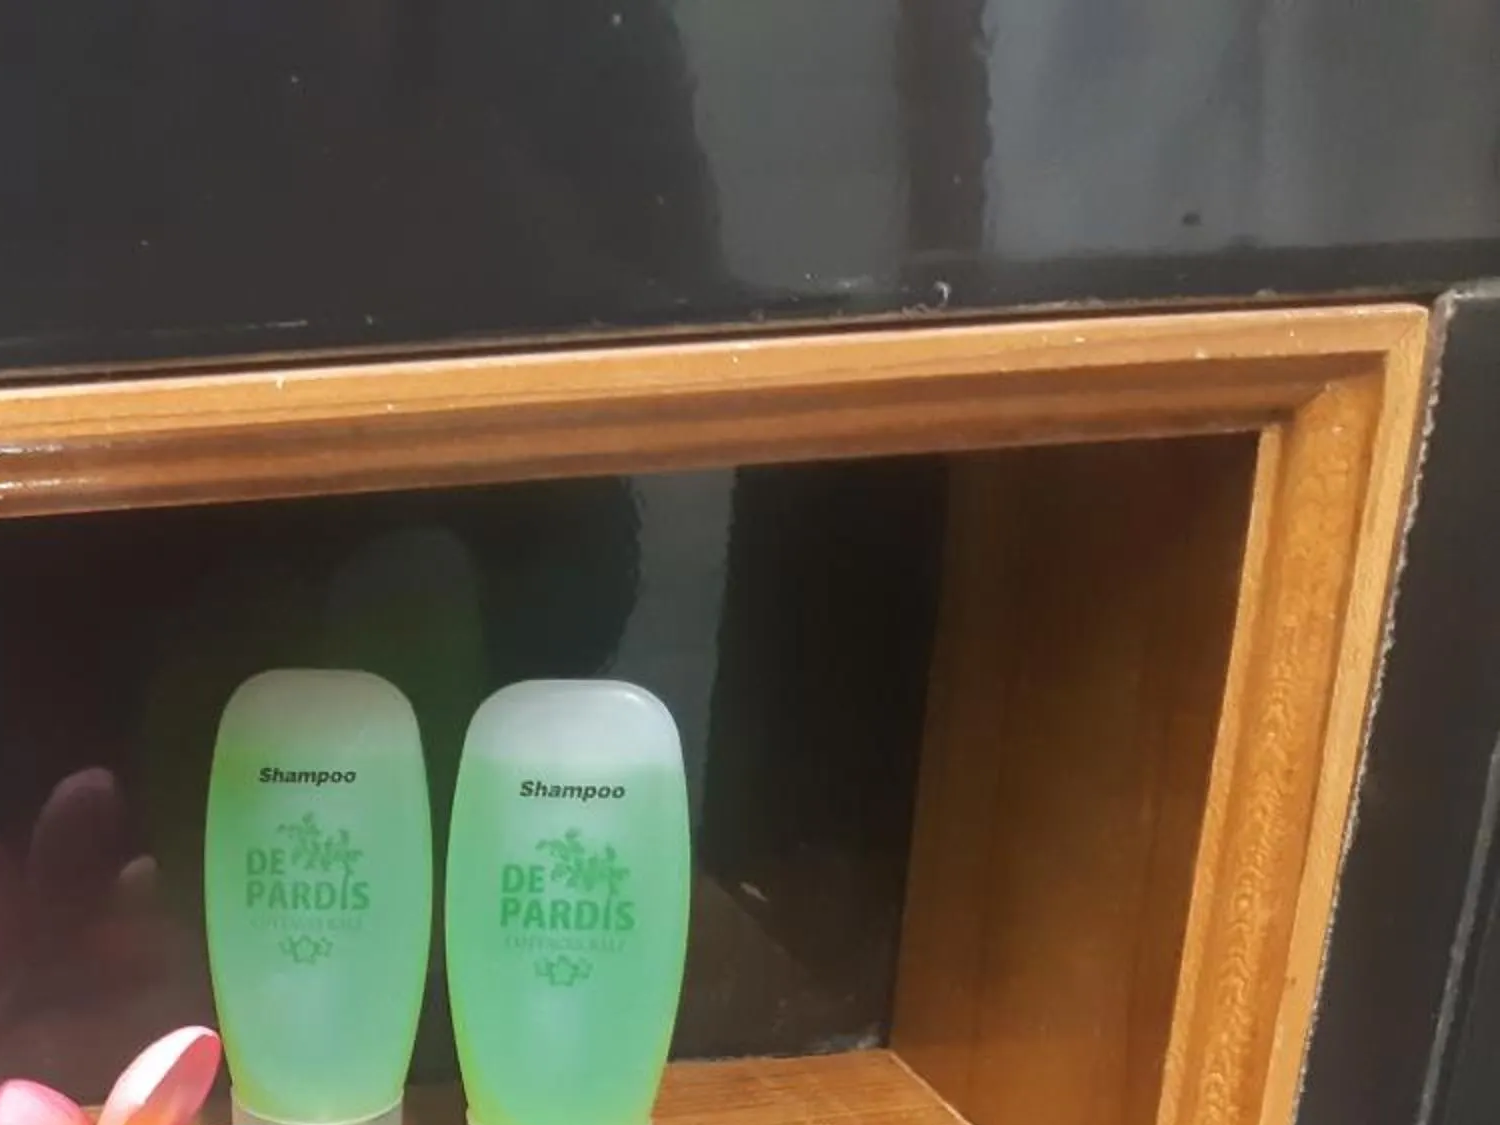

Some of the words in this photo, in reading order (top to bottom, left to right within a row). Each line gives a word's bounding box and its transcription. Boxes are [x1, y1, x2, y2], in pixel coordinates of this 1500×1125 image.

[258, 767, 357, 787] Shampoo
[519, 780, 626, 802] Shampoo
[246, 848, 286, 875] DE
[502, 864, 546, 893] DE
[246, 879, 370, 911] PARDIS
[500, 896, 636, 931] PARDIS
